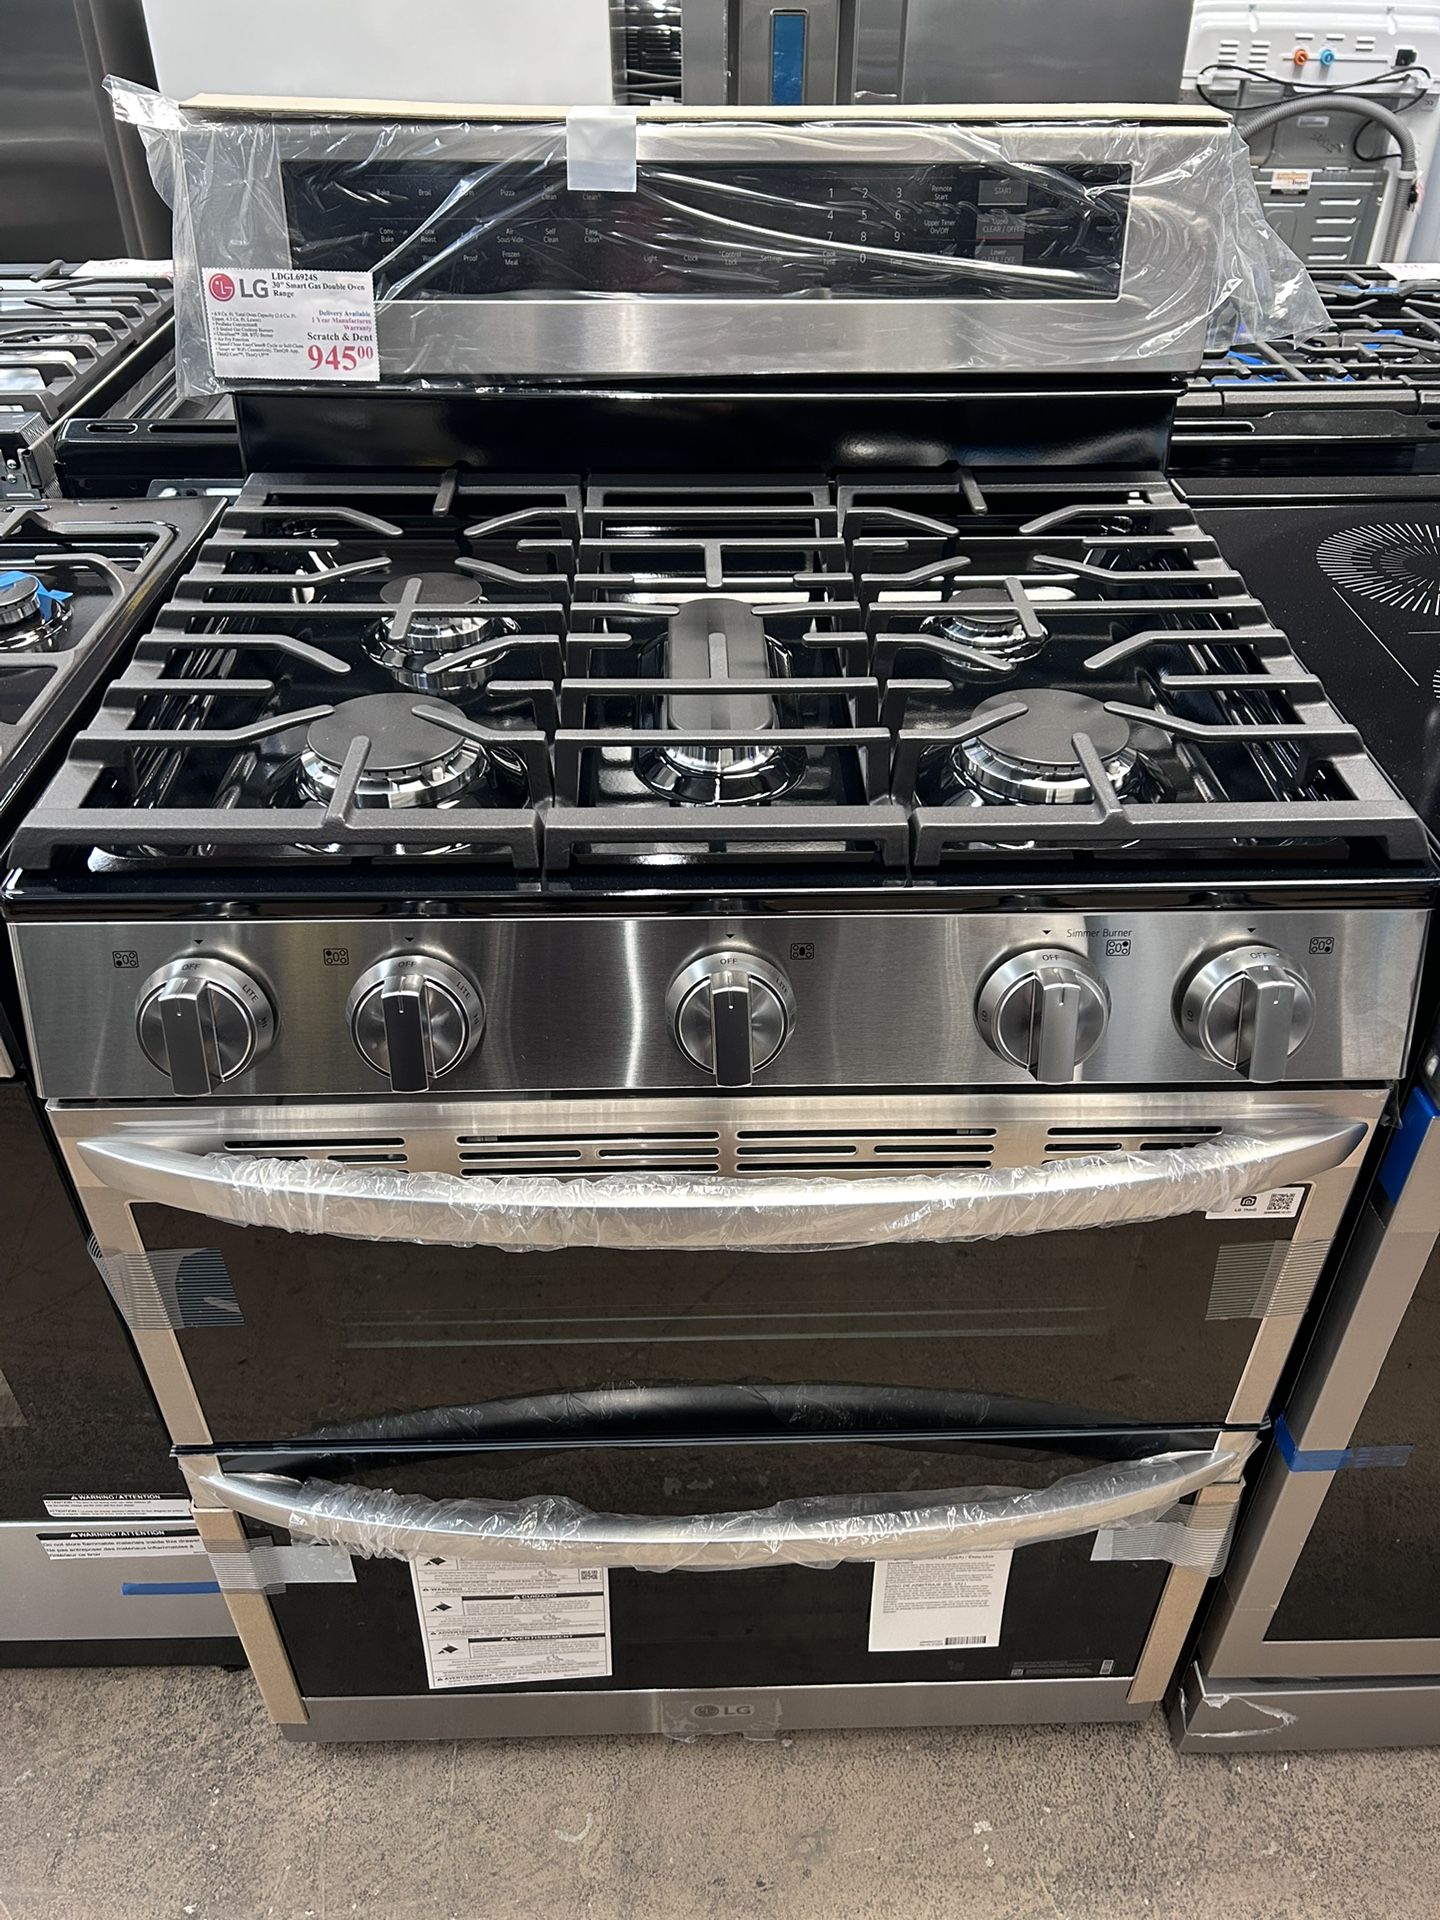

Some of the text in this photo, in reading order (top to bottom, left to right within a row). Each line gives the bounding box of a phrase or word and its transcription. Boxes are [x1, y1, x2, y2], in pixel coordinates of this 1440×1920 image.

[828, 188, 833, 198] 1
[862, 188, 868, 198] 2
[896, 188, 902, 198] 3
[828, 210, 834, 220] 4
[862, 210, 868, 220] 5
[895, 210, 901, 220] 6
[827, 232, 833, 240] 7
[860, 232, 866, 242] 8
[894, 232, 900, 242] 9
[860, 254, 866, 264] 0
[272, 272, 318, 281] LDGL6924S
[240, 278, 268, 298] LG
[274, 290, 294, 298] Range
[307, 332, 373, 341] Scratch & Dent
[1067, 928, 1132, 938] Simmer Burner
[241, 984, 259, 1002] LITE
[456, 982, 472, 999] LITE
[724, 1705, 751, 1715] LG
